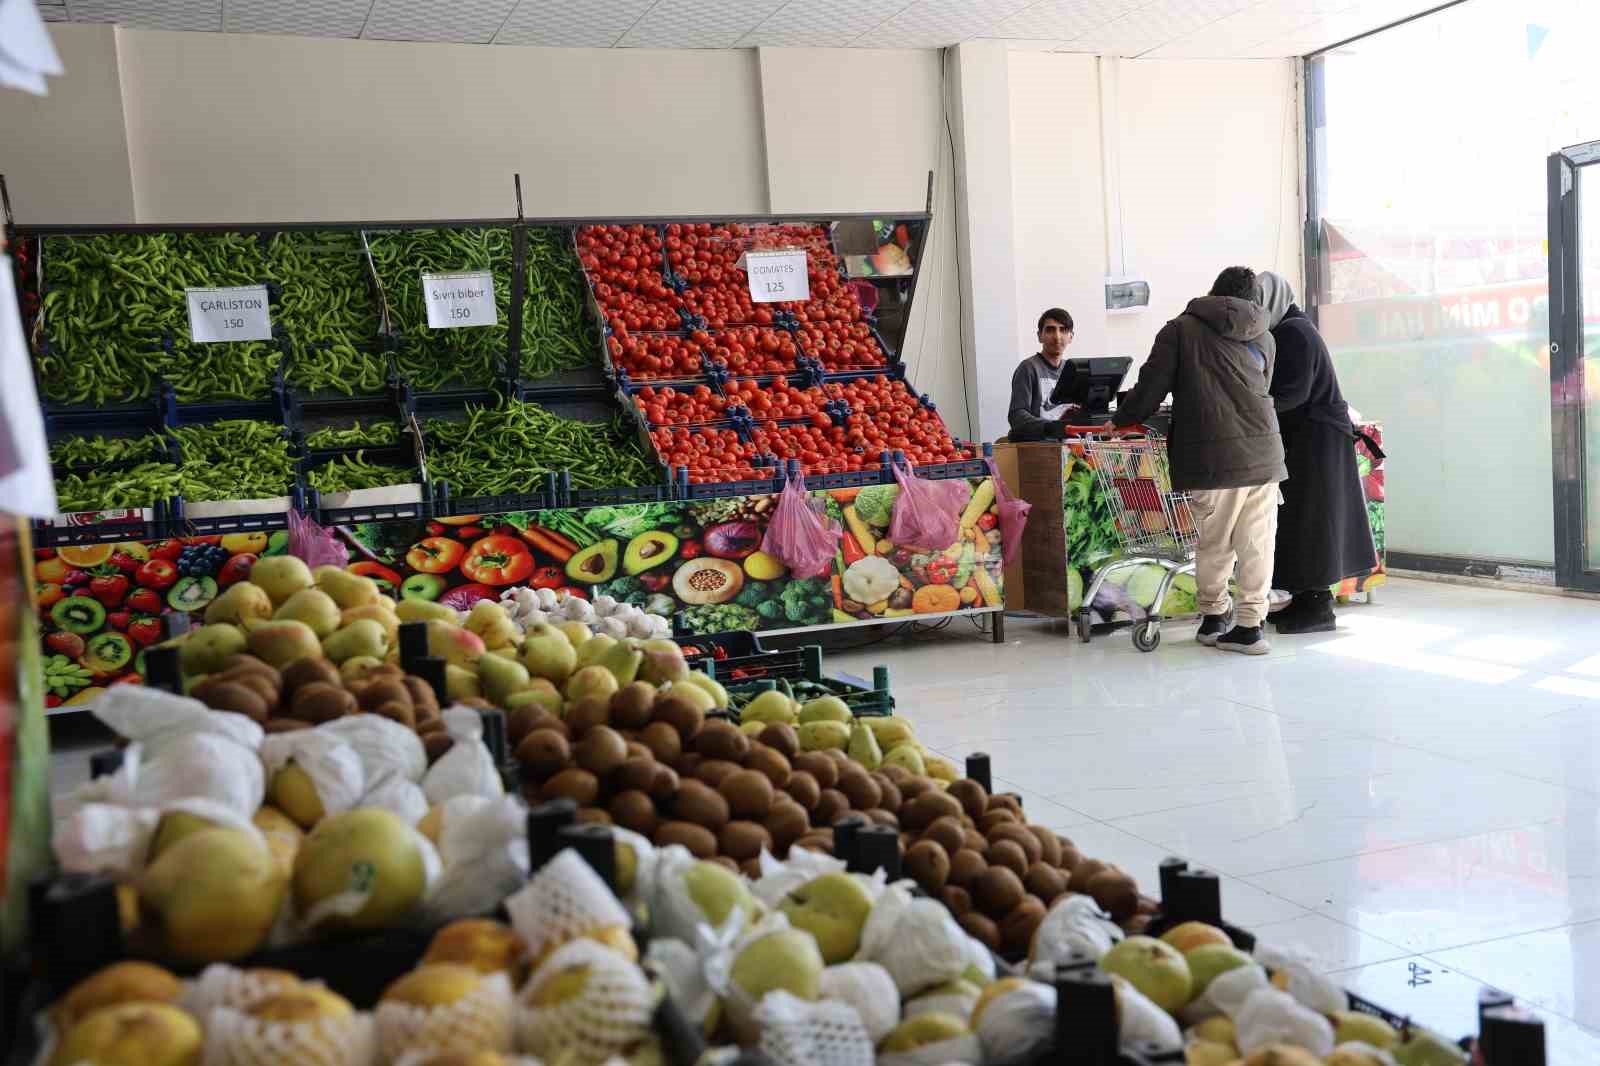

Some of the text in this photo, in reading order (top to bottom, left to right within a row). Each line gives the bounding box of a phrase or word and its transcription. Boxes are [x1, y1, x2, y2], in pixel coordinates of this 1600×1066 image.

[457, 287, 485, 299] biber
[766, 281, 785, 293] 125
[450, 307, 471, 319] 150
[223, 318, 244, 329] 150
